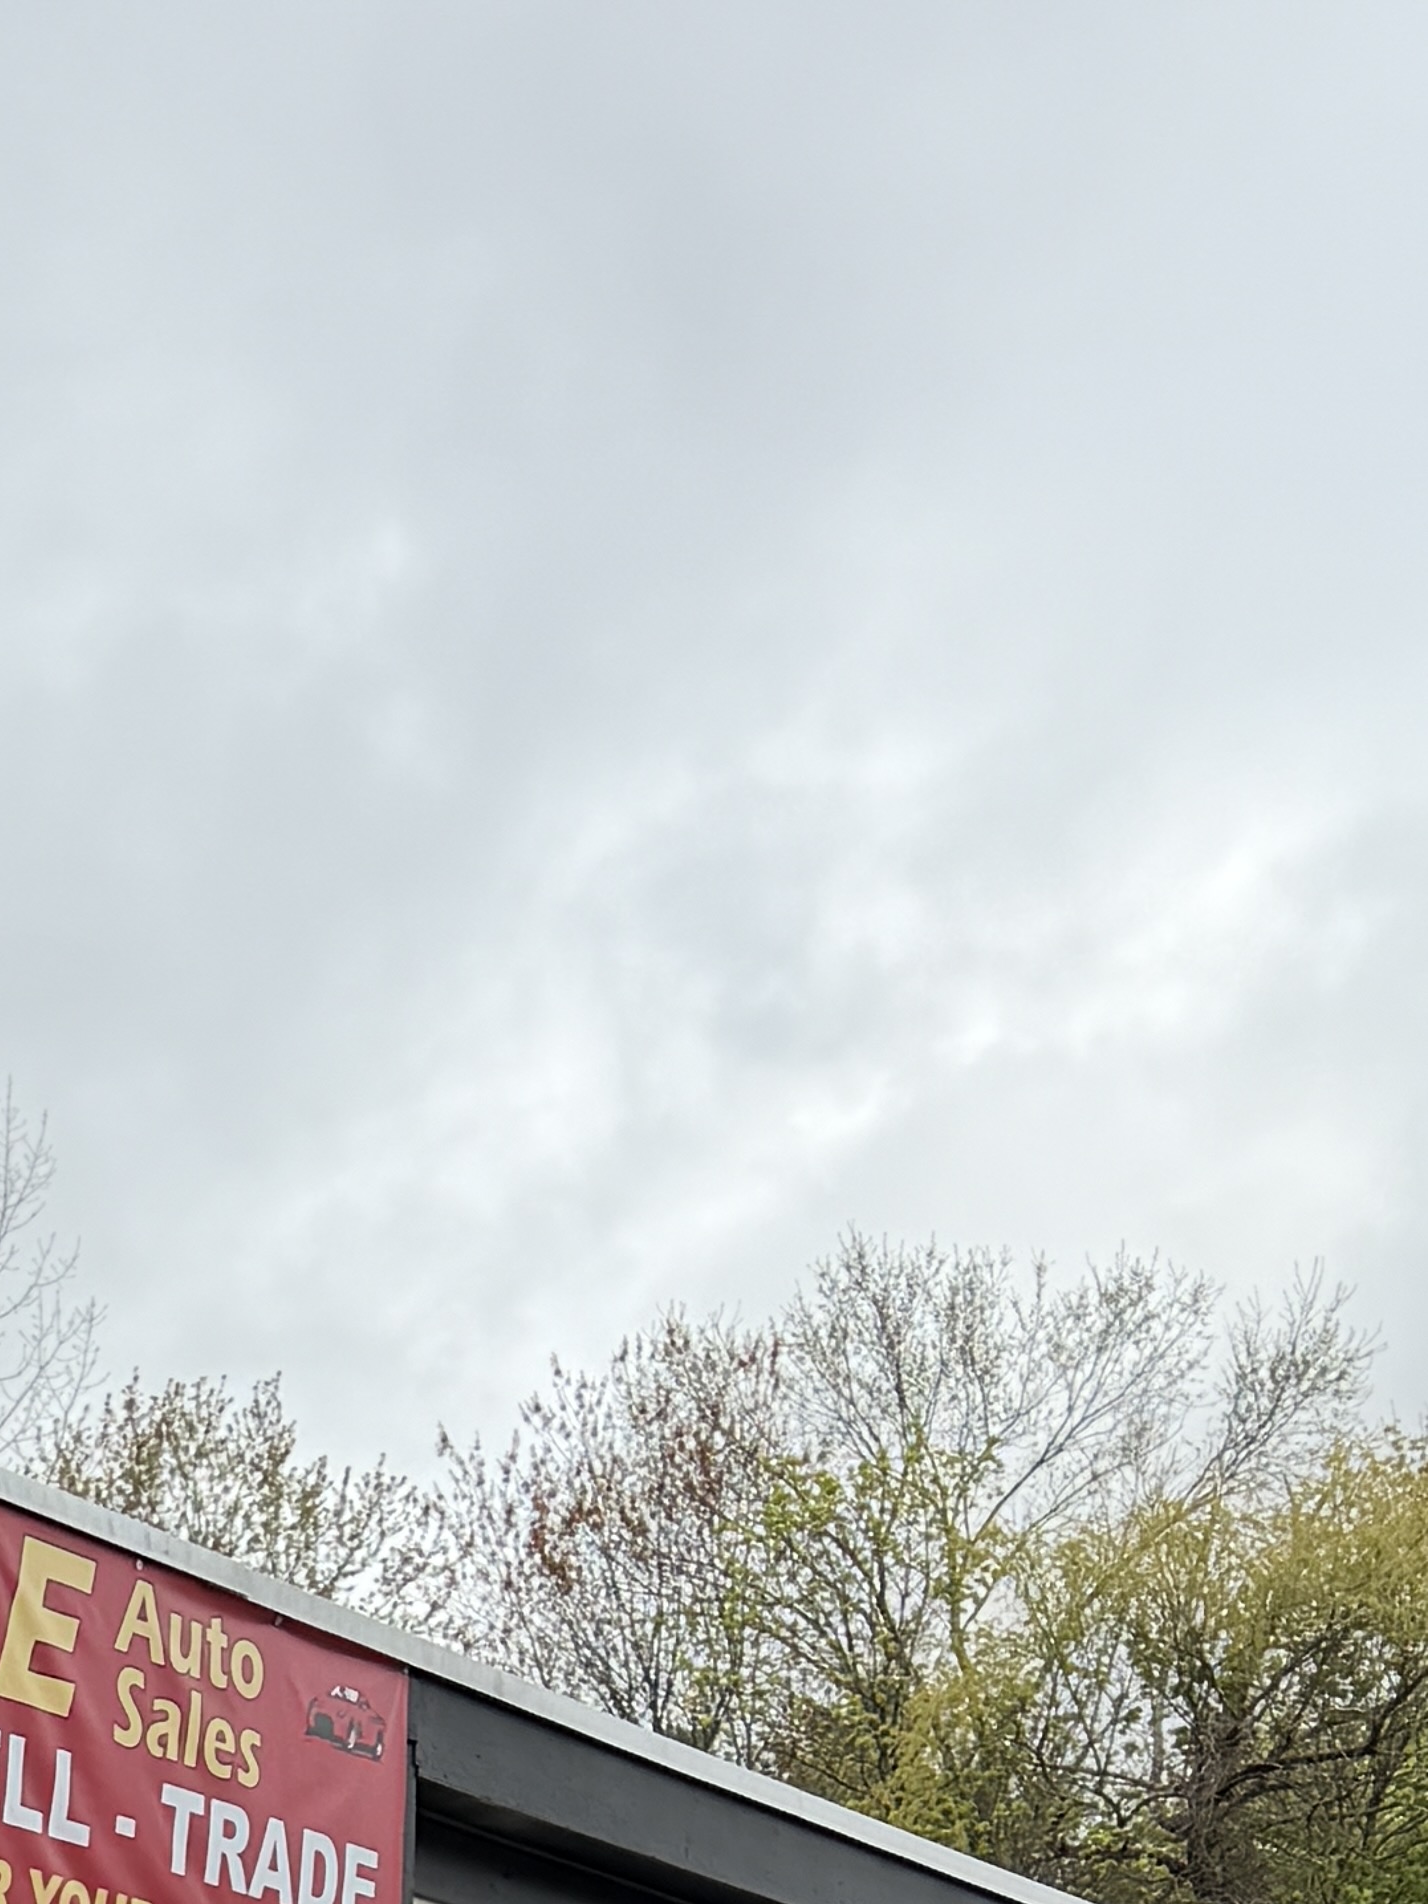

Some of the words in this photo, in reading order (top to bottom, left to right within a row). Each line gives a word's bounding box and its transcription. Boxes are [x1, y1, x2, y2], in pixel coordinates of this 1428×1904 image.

[114, 1580, 265, 1699] Auto
[112, 1668, 261, 1787] Sales
[115, 1816, 135, 1838] -
